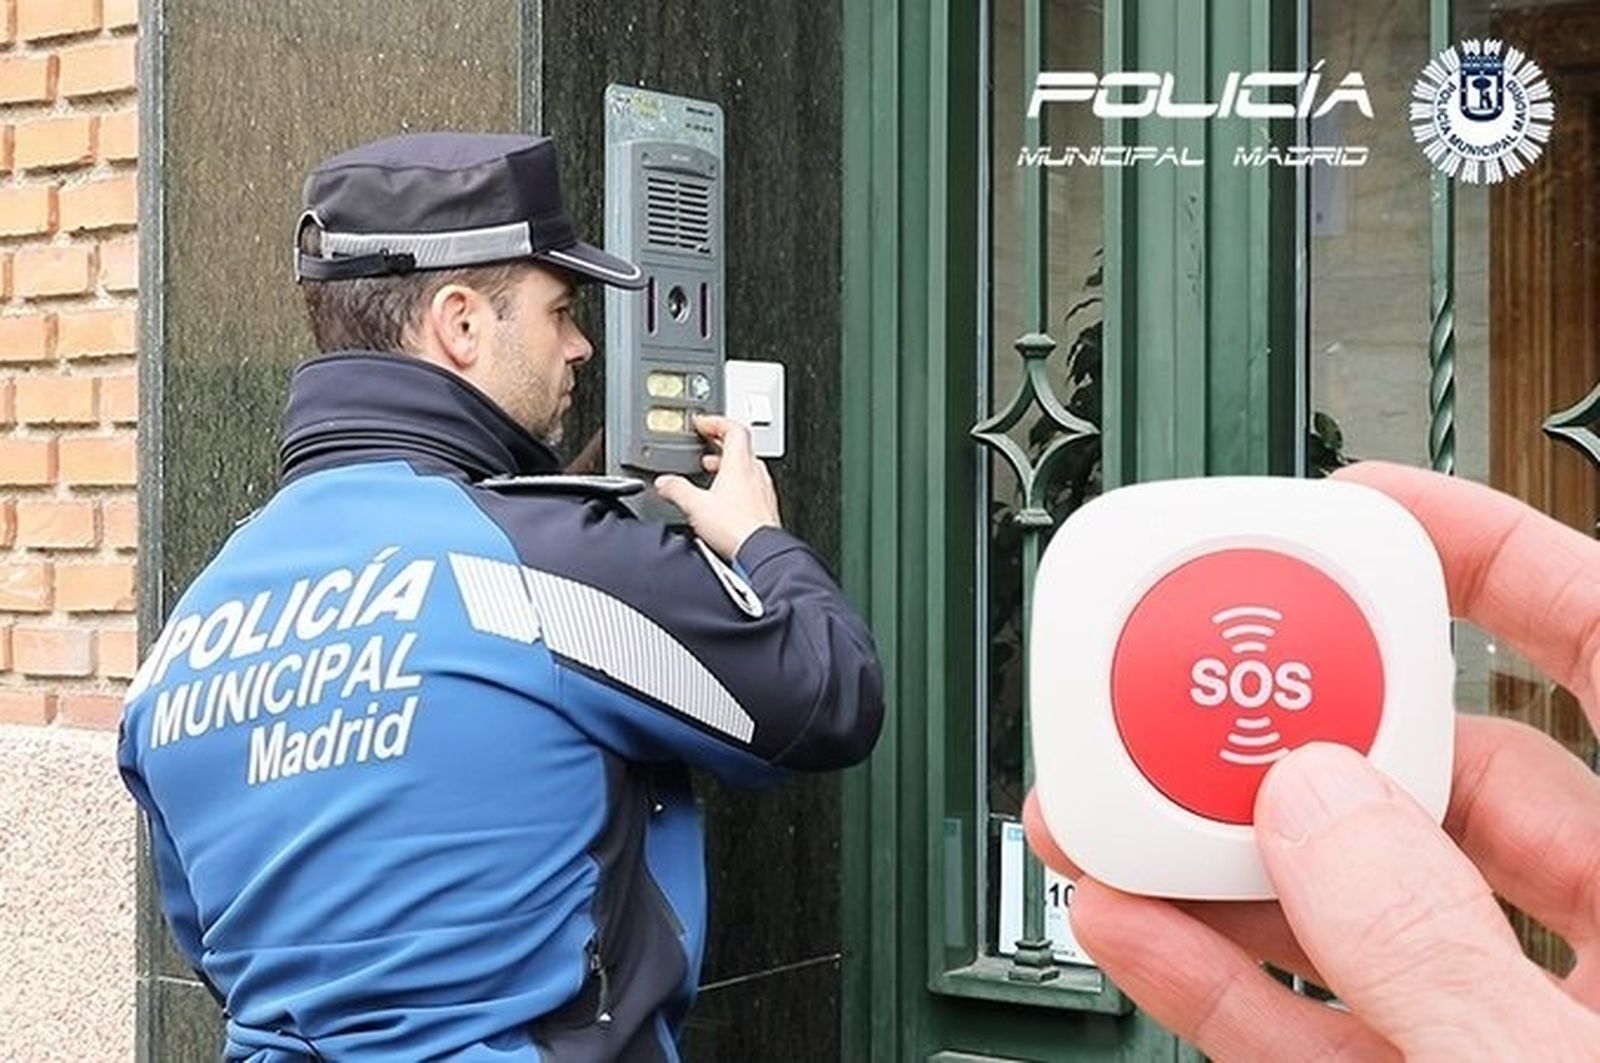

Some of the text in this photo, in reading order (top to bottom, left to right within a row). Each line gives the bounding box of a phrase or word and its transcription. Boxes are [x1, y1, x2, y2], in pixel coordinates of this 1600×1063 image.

[152, 546, 437, 686] POLICÍA
[151, 632, 422, 748] MUNICIPAL
[1190, 658, 1313, 710] SOS
[247, 696, 419, 785] Madrid
